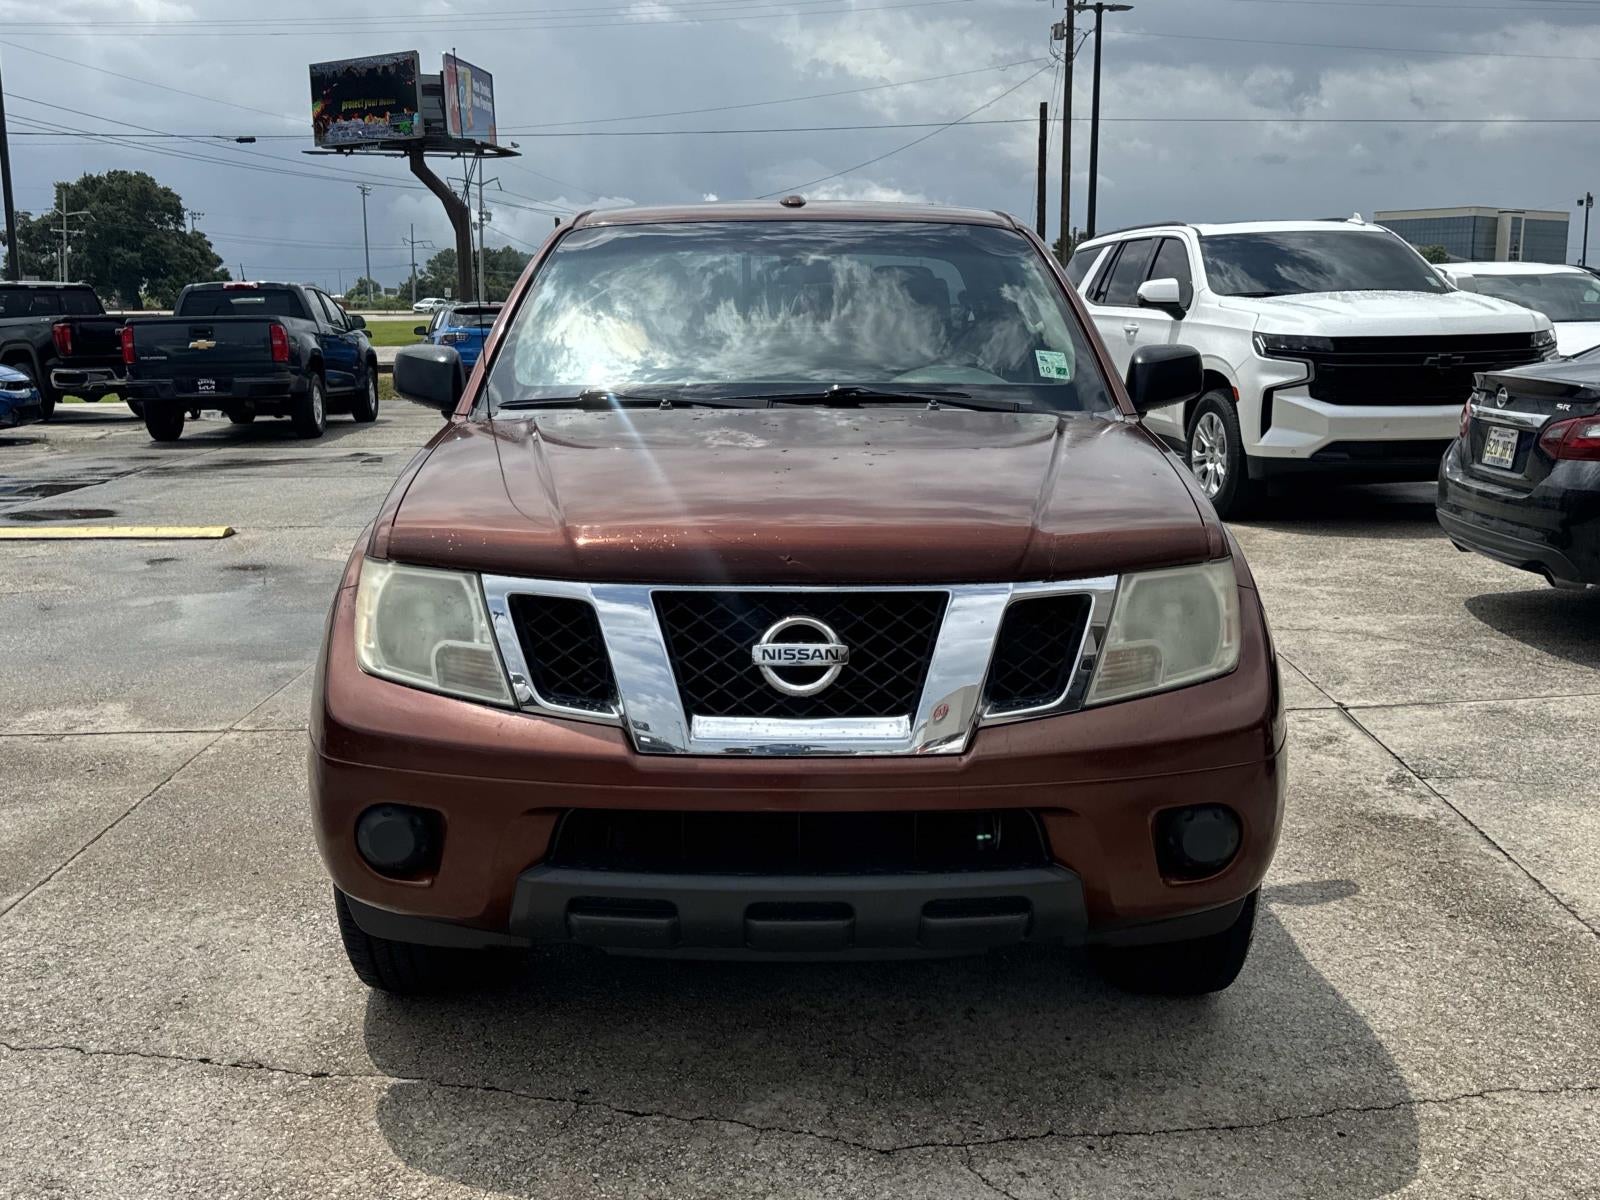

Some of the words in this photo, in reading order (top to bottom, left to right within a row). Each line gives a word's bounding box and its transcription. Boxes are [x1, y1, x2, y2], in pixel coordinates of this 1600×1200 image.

[342, 99, 364, 112] protect
[364, 99, 378, 110] your
[1041, 366, 1051, 374] 10
[1556, 403, 1571, 412] SR
[762, 648, 839, 661] NISSAN
